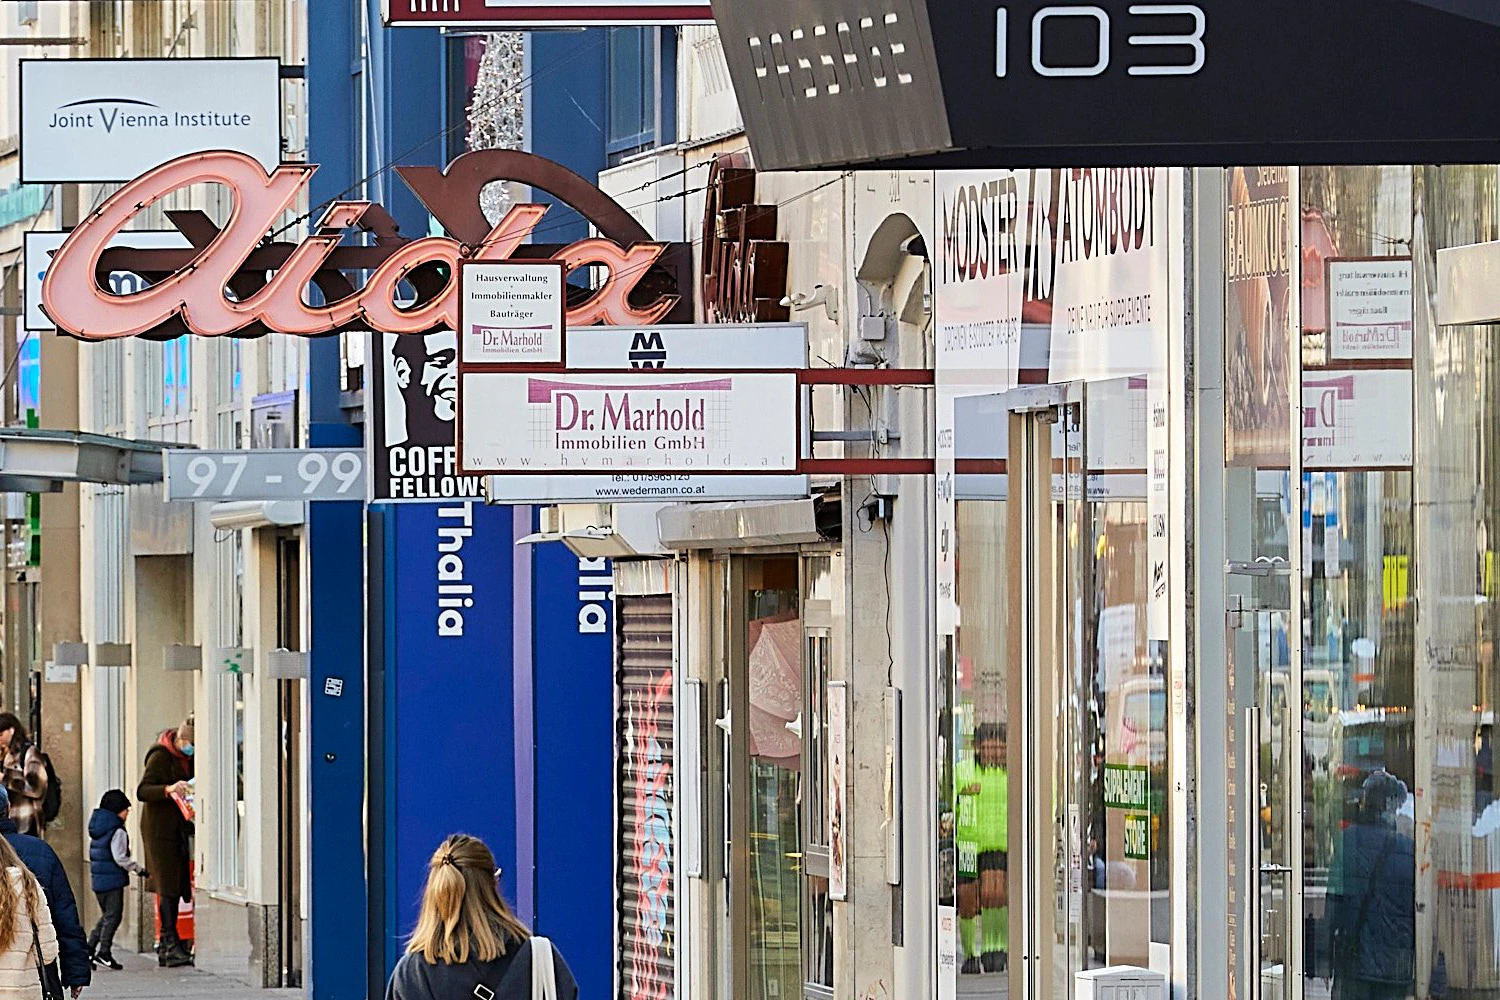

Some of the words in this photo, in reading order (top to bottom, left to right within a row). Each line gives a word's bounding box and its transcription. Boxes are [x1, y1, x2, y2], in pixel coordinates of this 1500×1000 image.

[749, 13, 913, 104] PASSAGE
[996, 5, 1206, 77] 103
[49, 113, 93, 128] Joint
[100, 107, 168, 133] Vienna
[175, 112, 251, 127] Institute
[942, 176, 1018, 285] MODSTER
[1061, 168, 1156, 264] ATOMBODY
[41, 148, 682, 338] Aida
[471, 292, 552, 300] Immobilienmakler
[476, 273, 548, 284] Hausverwaltung
[490, 310, 533, 319] Bauträger
[483, 330, 499, 346] Dr.
[501, 330, 542, 346] Marhold
[555, 392, 594, 431] Dr.
[602, 392, 705, 431] Marhold
[556, 432, 647, 450] Immobilien
[654, 432, 705, 450] GmbH
[187, 455, 248, 497] 97
[298, 452, 362, 494] 99
[595, 485, 705, 496] www.wedermann.co.at
[431, 500, 474, 637] Thalia
[1104, 767, 1146, 805] SUPPLEMENT
[1124, 819, 1146, 855] STORE
